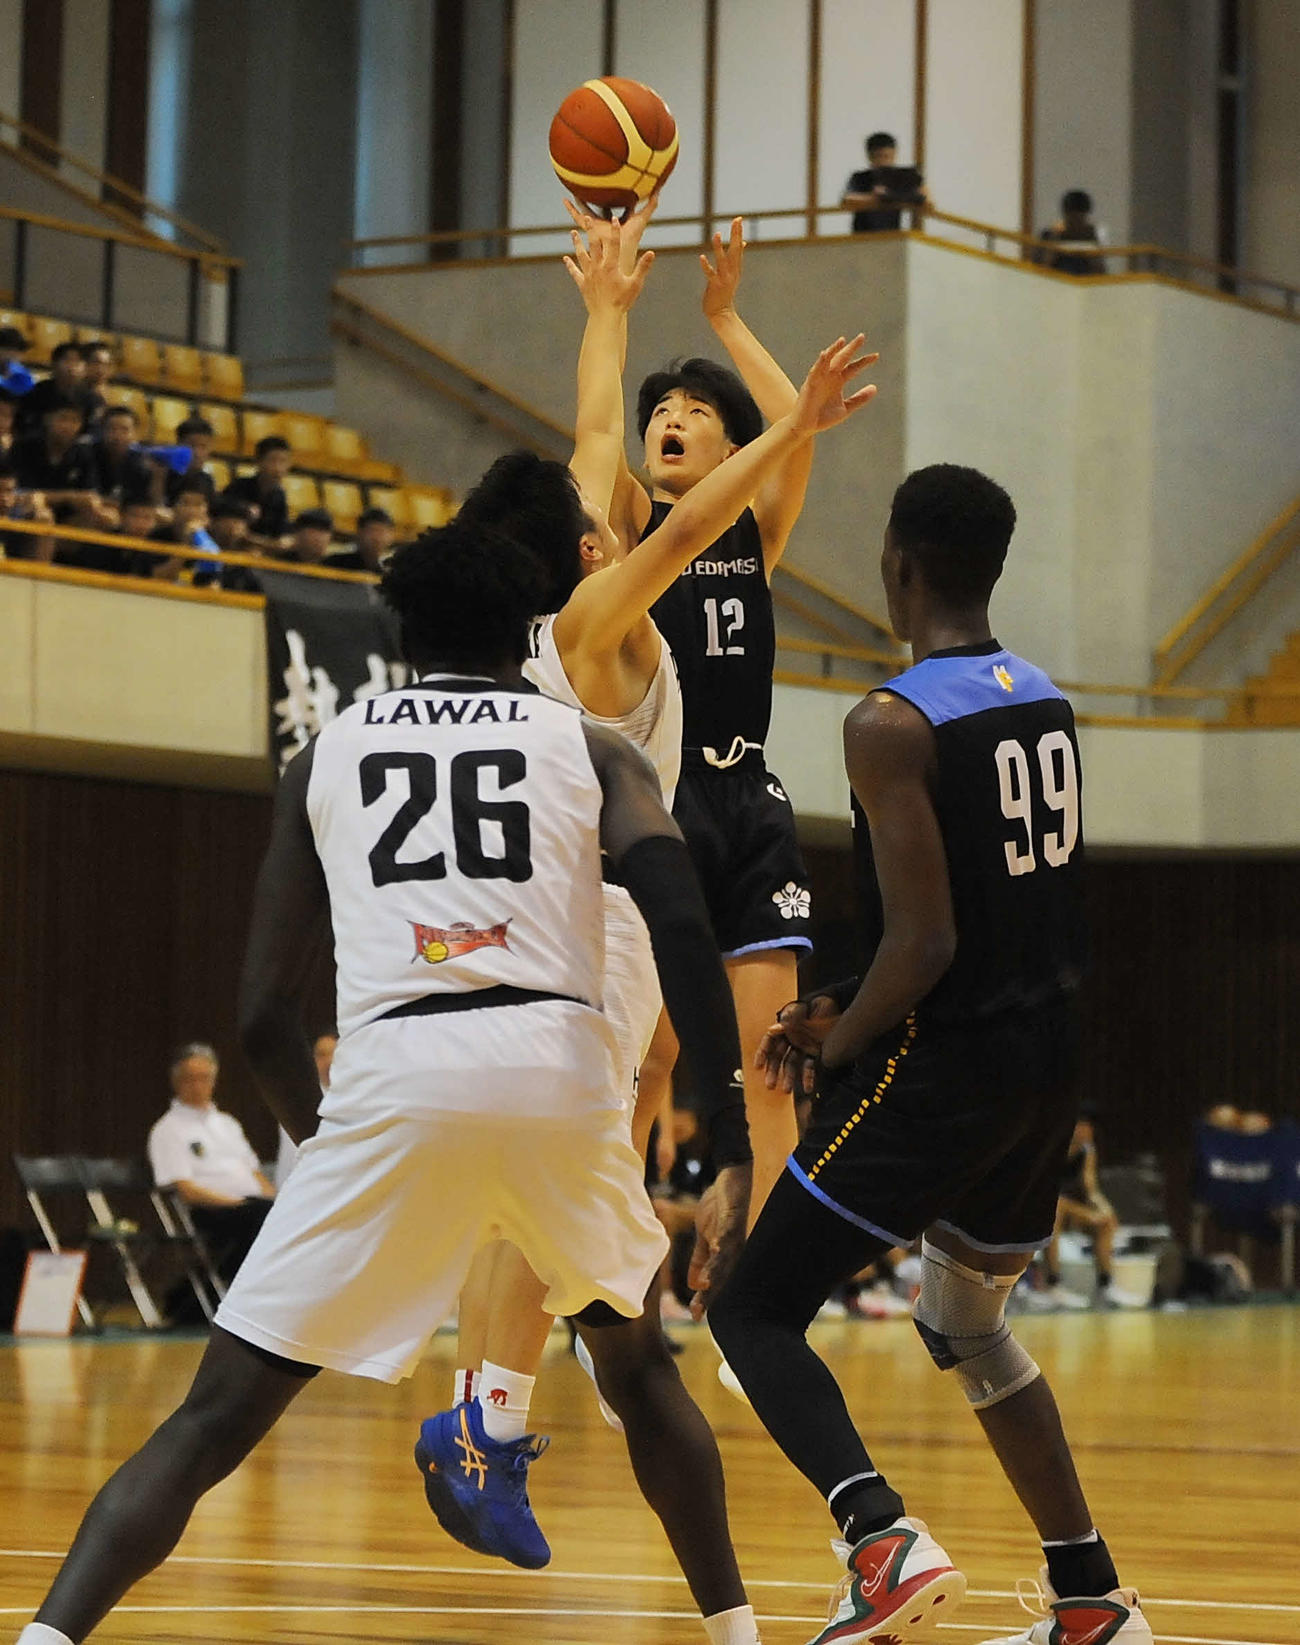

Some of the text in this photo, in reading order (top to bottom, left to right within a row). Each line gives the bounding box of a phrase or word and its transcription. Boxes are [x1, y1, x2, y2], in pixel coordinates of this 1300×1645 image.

[704, 598, 745, 656] 12
[362, 698, 530, 725] LAWAL
[359, 749, 533, 888] 26
[994, 730, 1079, 876] 99
